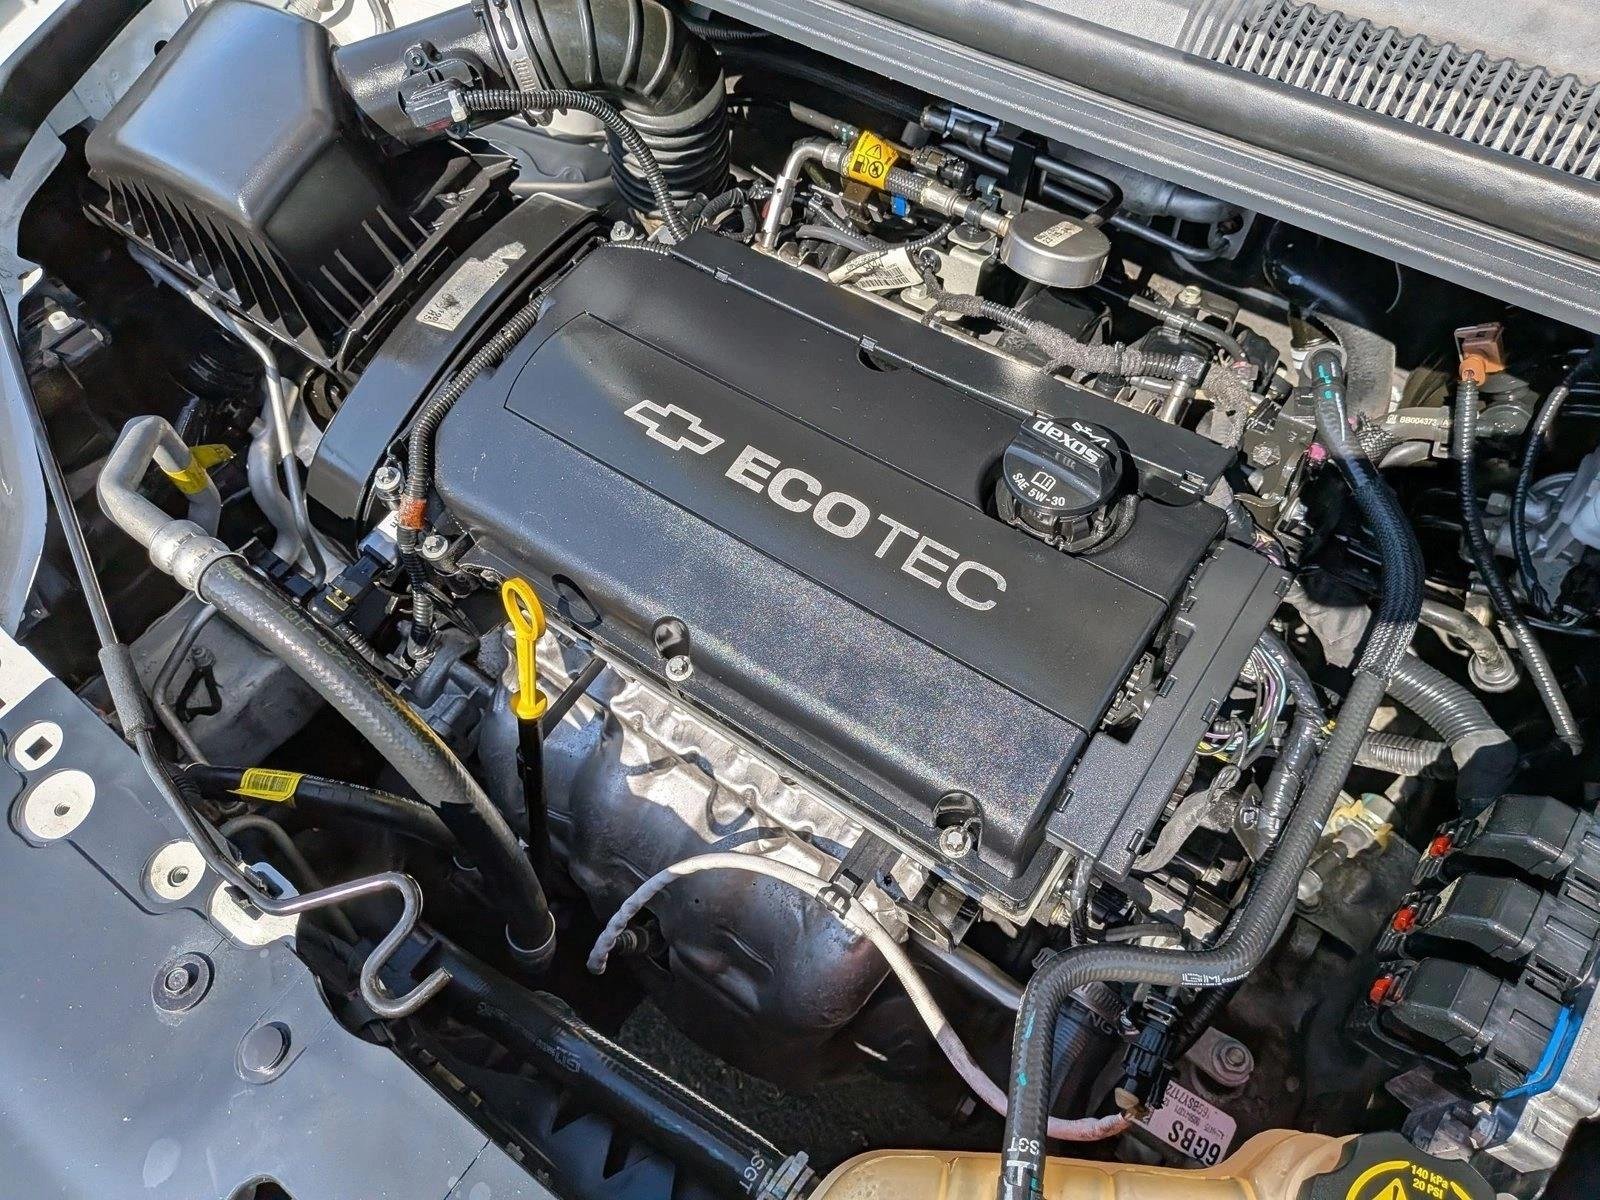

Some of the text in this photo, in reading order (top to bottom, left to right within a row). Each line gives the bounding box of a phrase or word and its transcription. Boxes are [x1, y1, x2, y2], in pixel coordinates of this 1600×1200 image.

[1032, 420, 1104, 464] dexos
[1012, 472, 1066, 507] SAE 5W-30
[725, 445, 1007, 611] ECOTEC
[1181, 972, 1220, 984] GM
[1007, 1136, 1041, 1156] SGT
[1168, 1120, 1221, 1166] 6GBS
[739, 1154, 765, 1196] SGT
[1411, 1164, 1449, 1190] 140 kPa
[1412, 1178, 1444, 1200] 20 PSI
